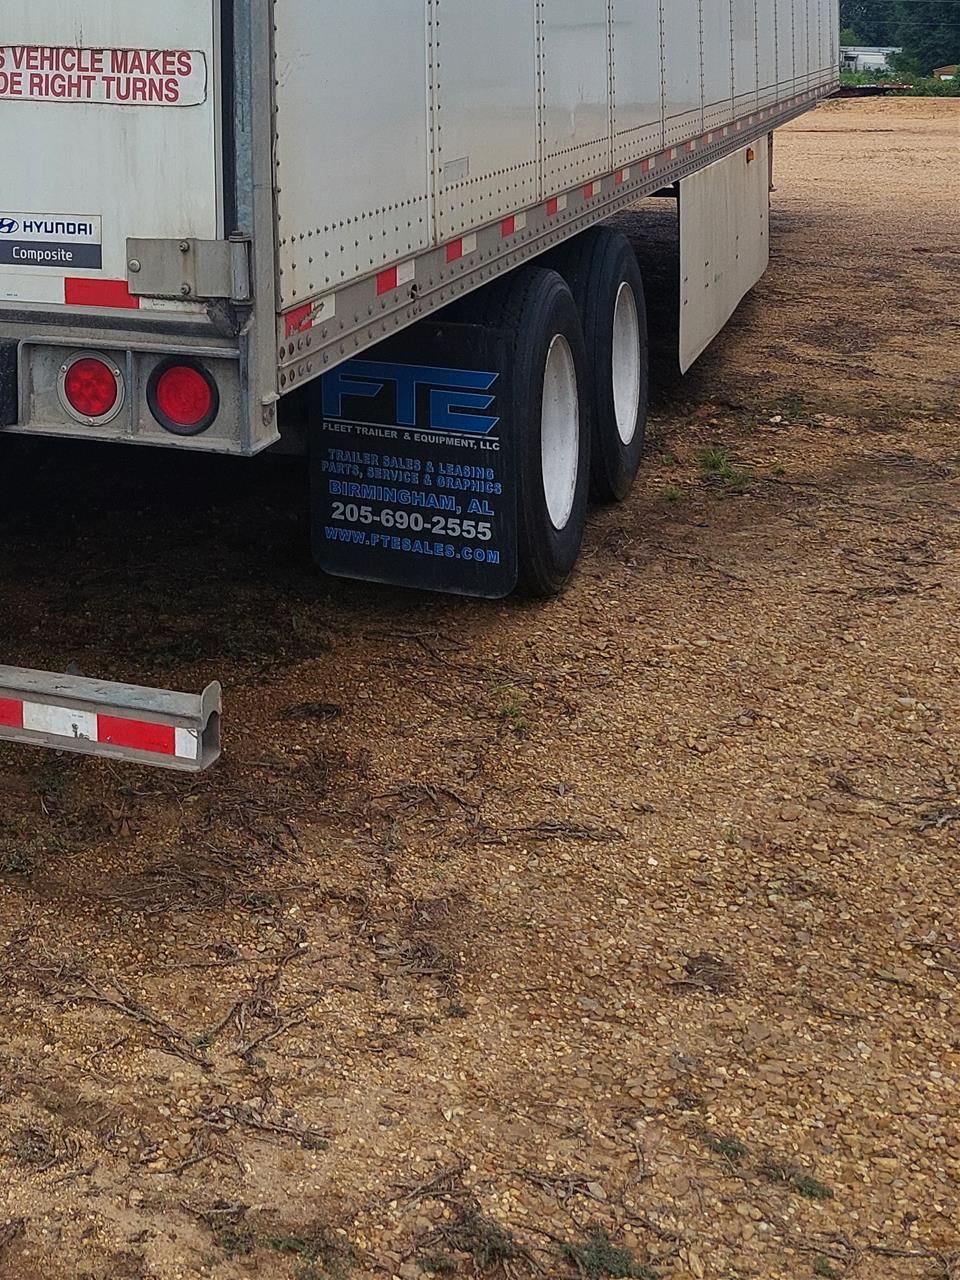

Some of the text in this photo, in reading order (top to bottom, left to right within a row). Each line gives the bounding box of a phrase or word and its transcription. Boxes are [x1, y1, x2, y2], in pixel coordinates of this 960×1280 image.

[11, 47, 104, 74] VEHICLE
[111, 50, 192, 76] MAKES
[30, 73, 96, 99] RIGHT
[101, 76, 180, 103] TURNS
[23, 220, 93, 236] HYUNDAI
[12, 245, 73, 262] Composite
[322, 359, 500, 434] FTE
[322, 422, 500, 451] FLEET TRAILER & EQUIPMENT, LLC
[321, 460, 502, 495] PARTS, SERVICE & GRAPHICS
[328, 448, 495, 481] TRAILER SALES & LEASING
[329, 479, 495, 516] BIRMINGHAM, AL
[331, 501, 492, 541] 205-690-2555
[324, 526, 500, 564] WWW.FTESALES.COM
